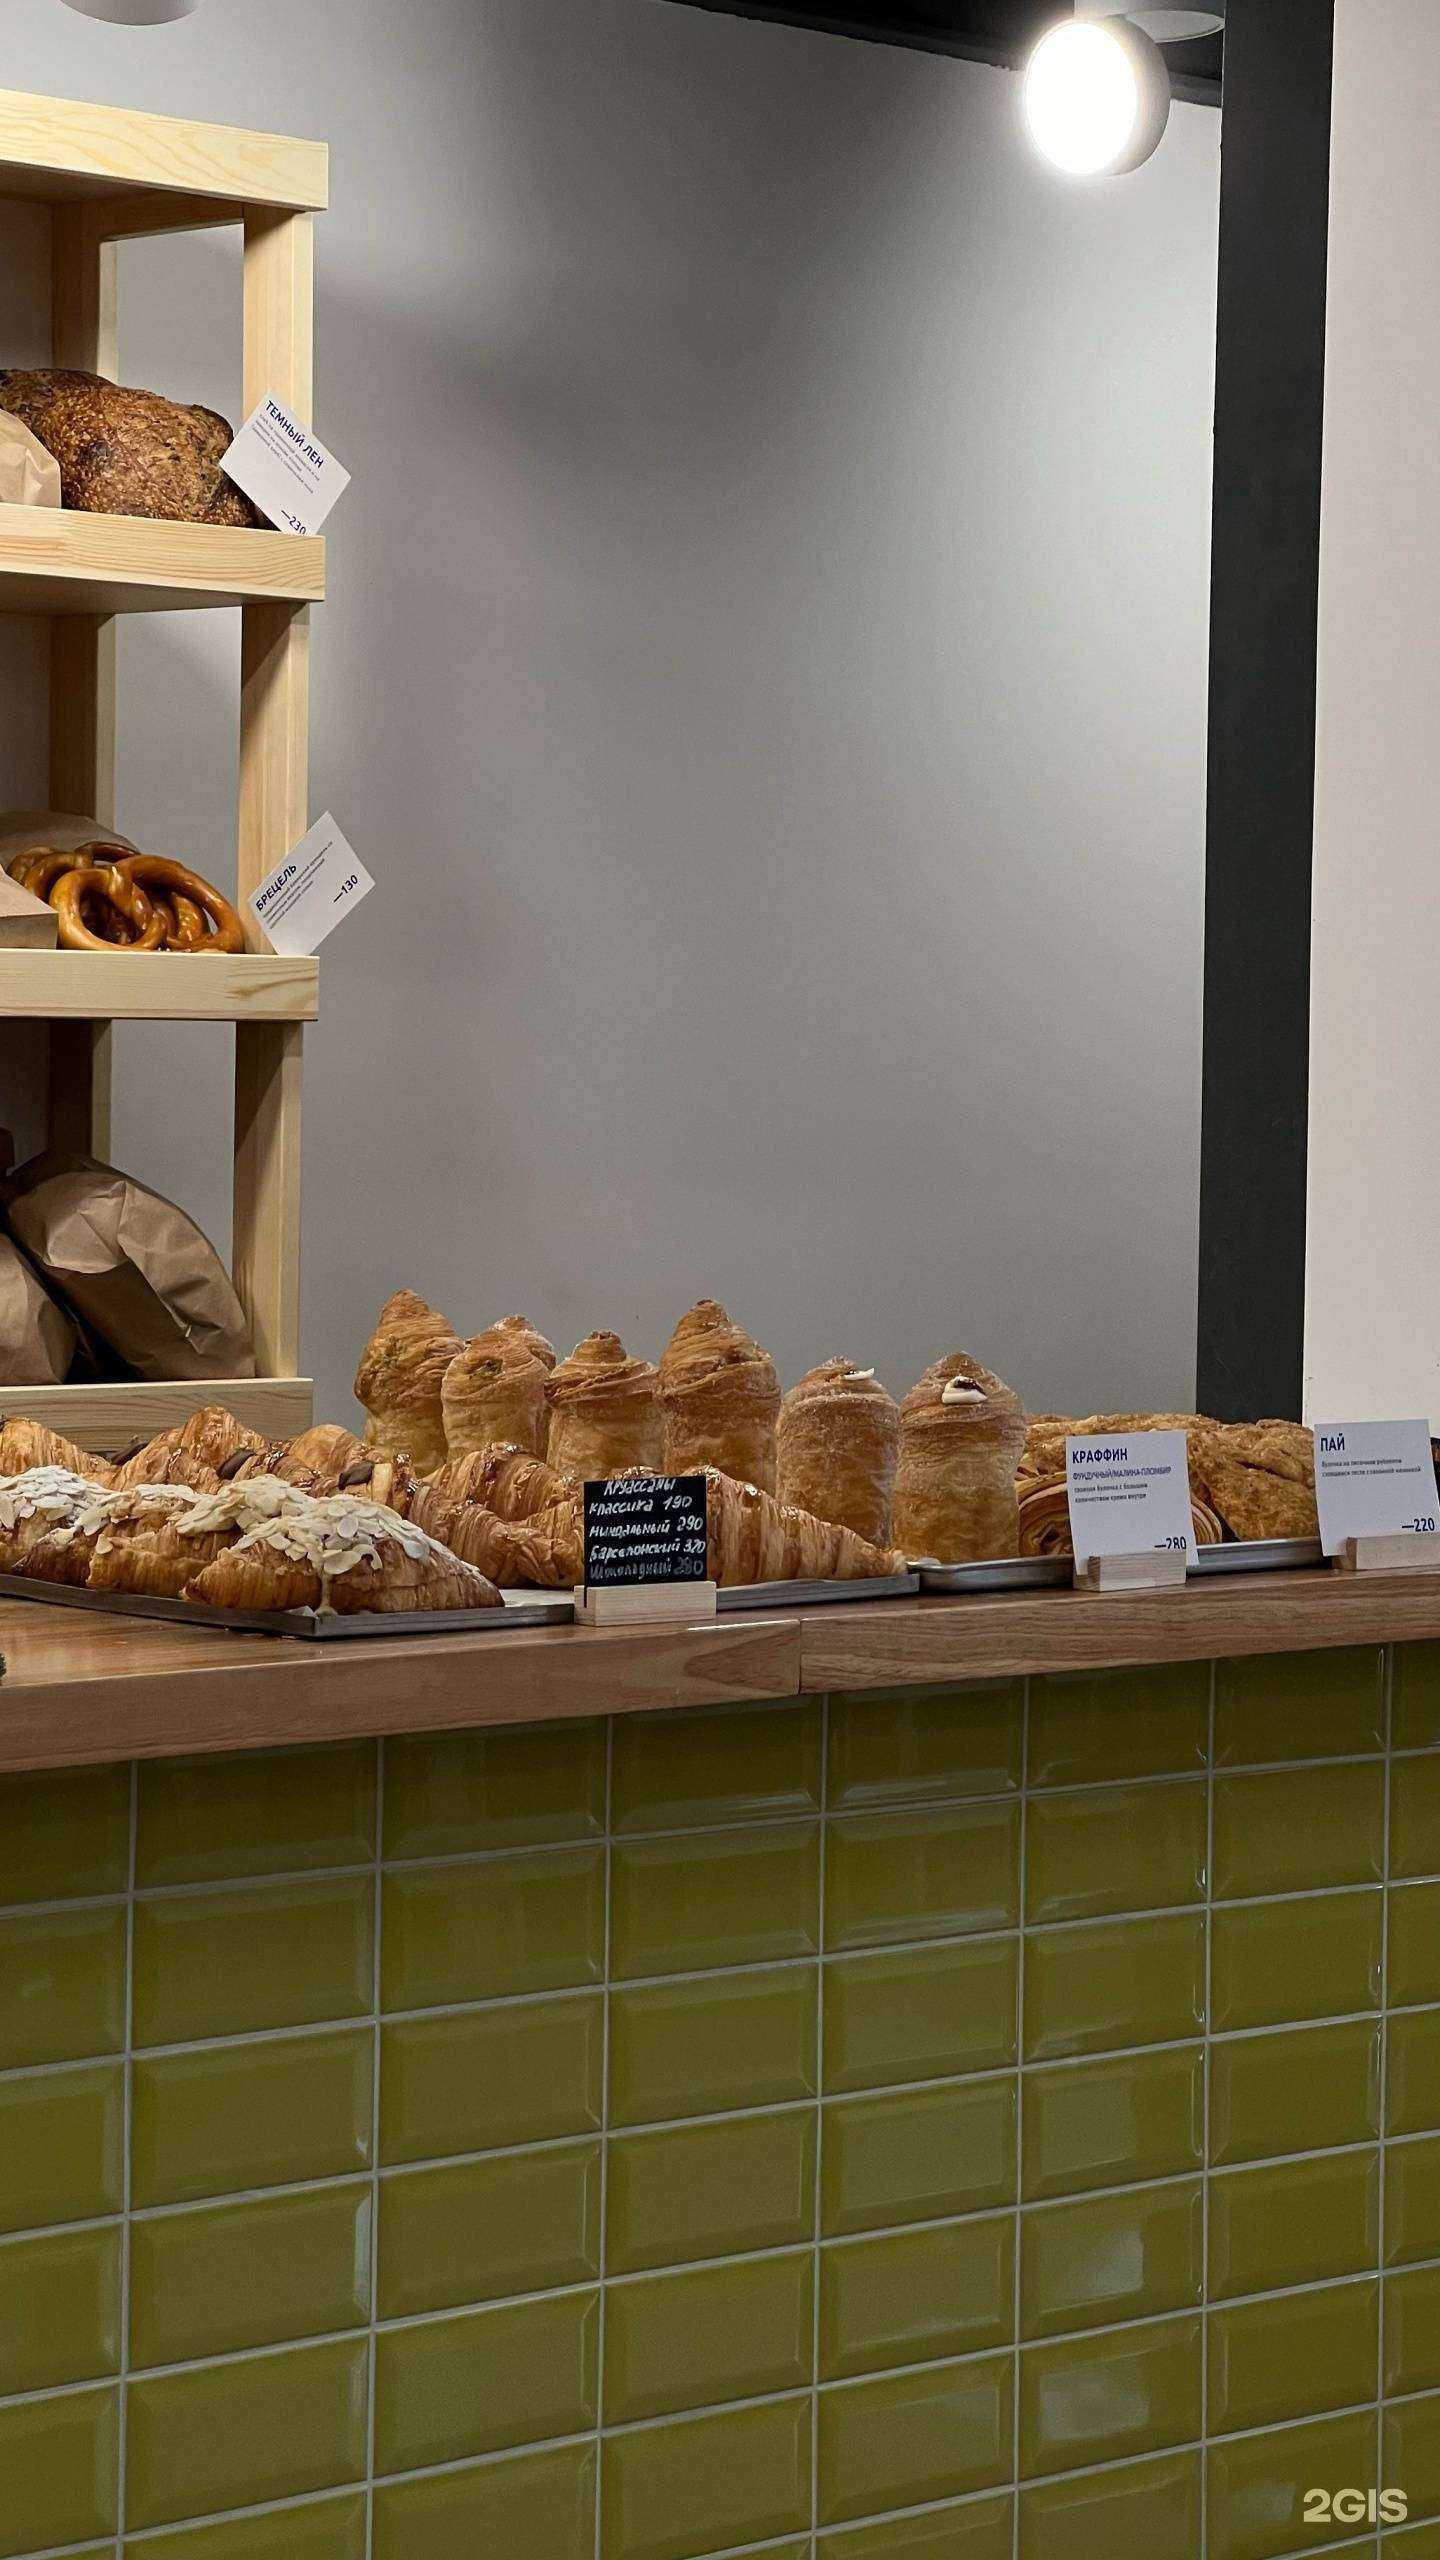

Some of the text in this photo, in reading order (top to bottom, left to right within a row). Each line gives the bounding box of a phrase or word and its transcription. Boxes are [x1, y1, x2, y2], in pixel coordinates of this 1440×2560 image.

[265, 400, 306, 447] ТЕМНЫЙ
[303, 445, 324, 468] ЛЕН
[256, 864, 297, 911] БРЕЦЕЛЬ
[1320, 1433, 1345, 1452] ПАЙ
[1072, 1448, 1128, 1464] КРАФФИН
[663, 1495, 692, 1511] 190
[676, 1515, 703, 1532] 290
[683, 1538, 706, 1553] 320
